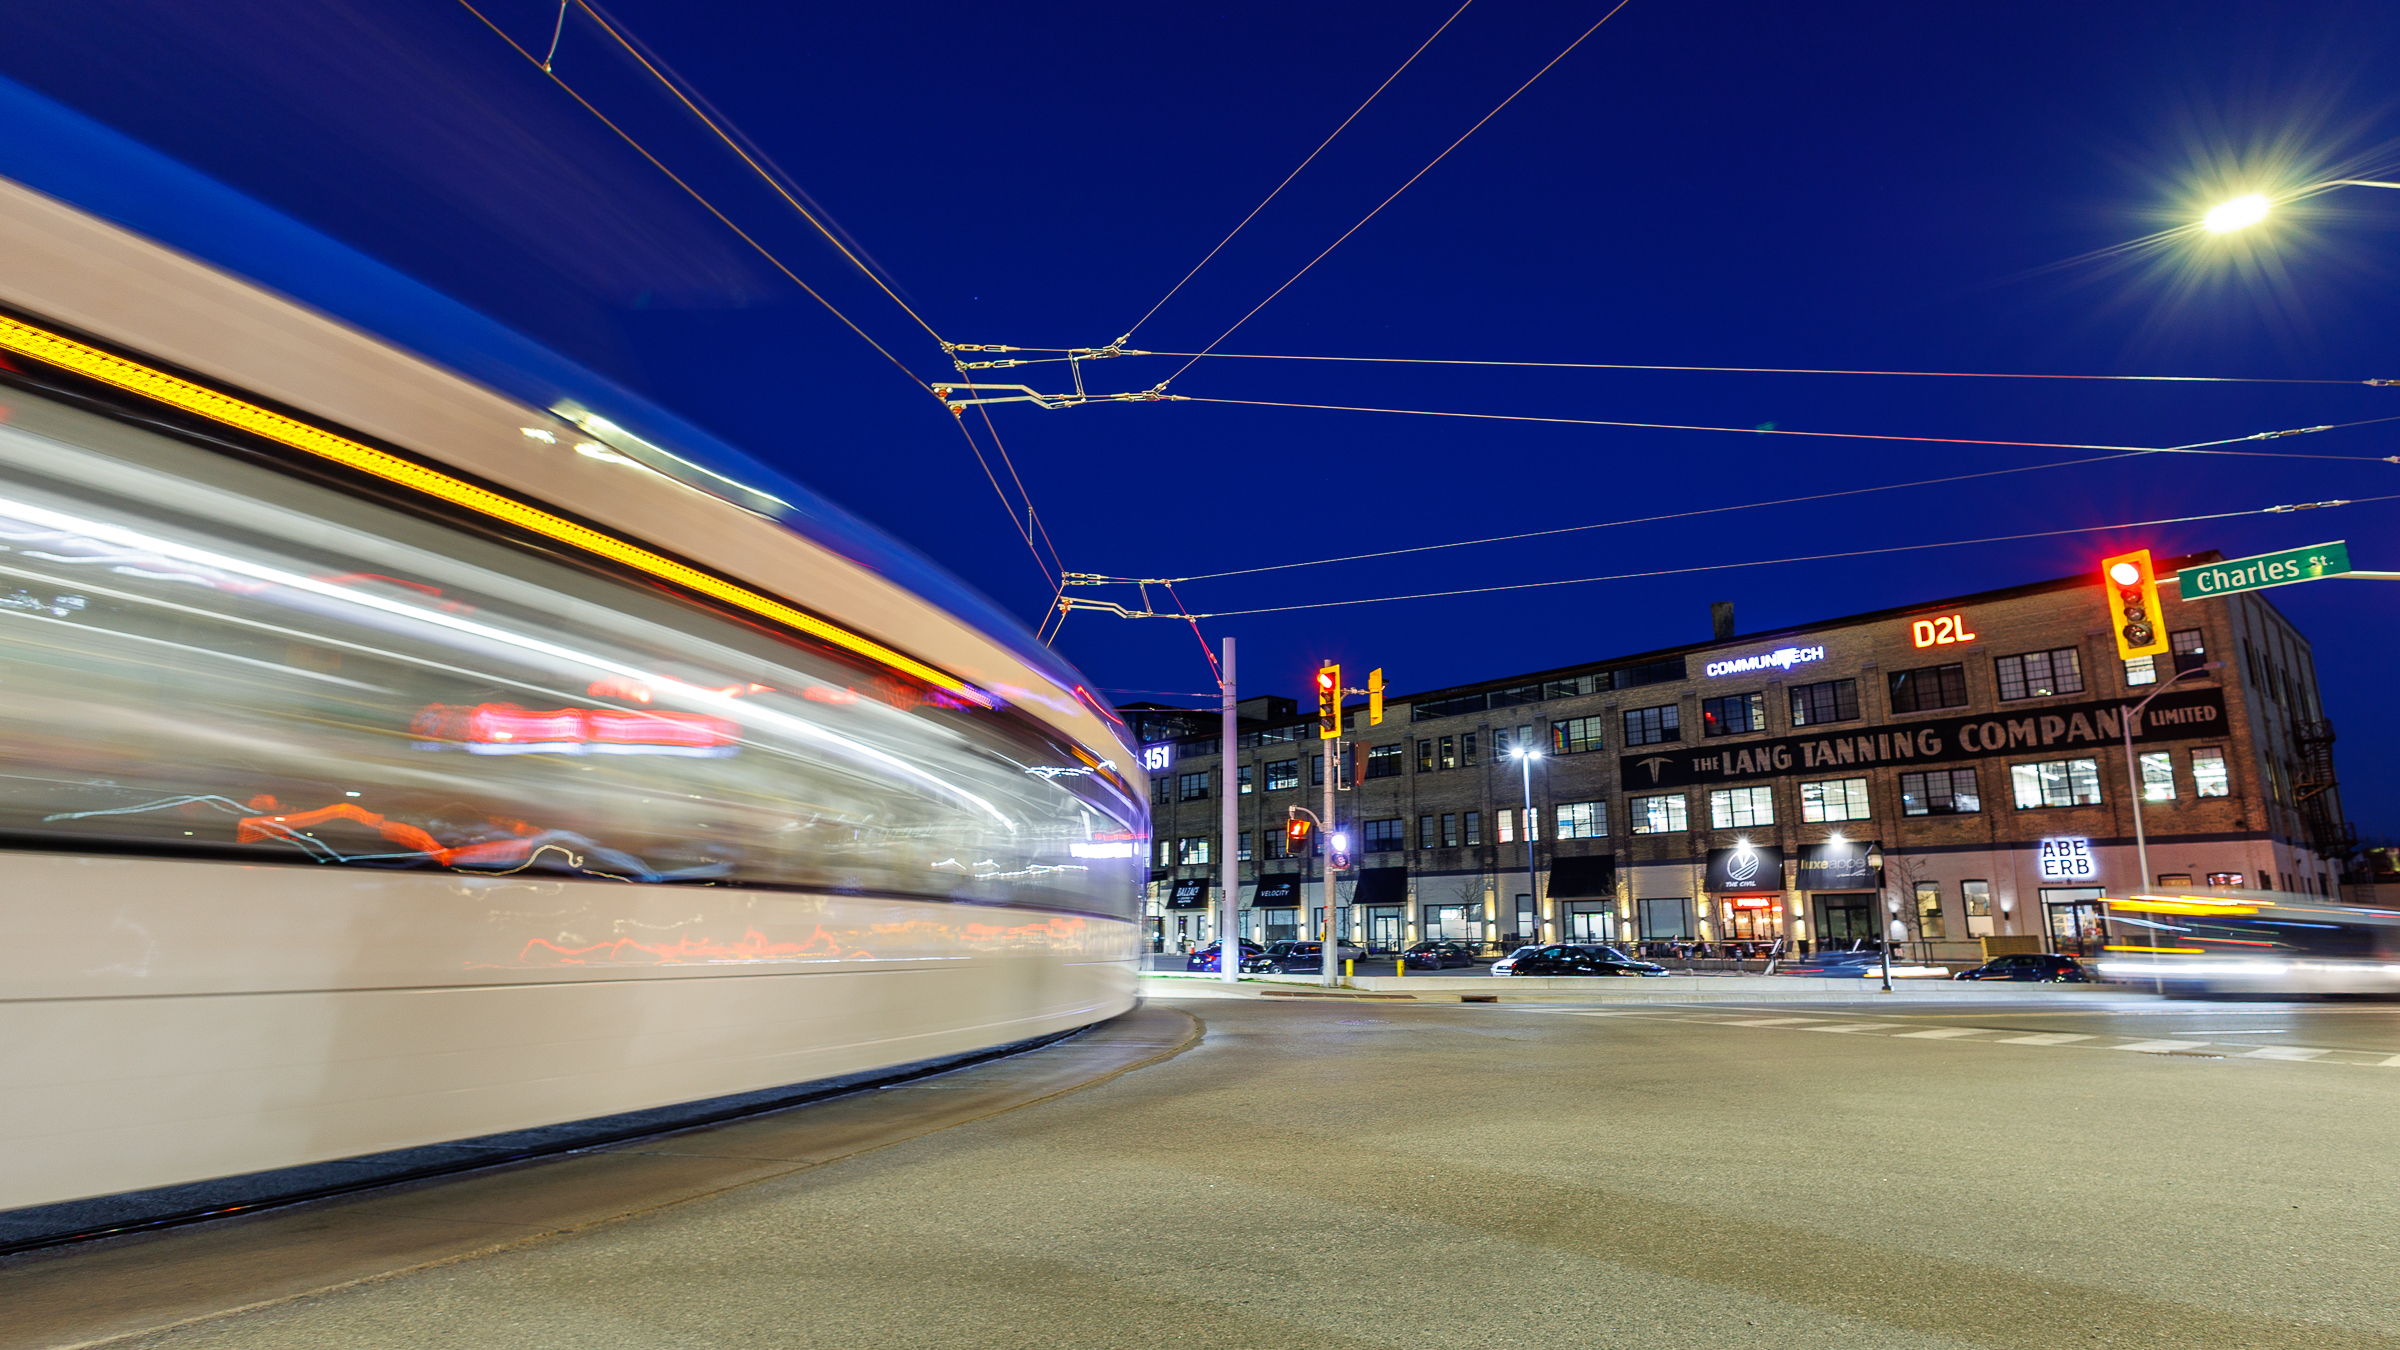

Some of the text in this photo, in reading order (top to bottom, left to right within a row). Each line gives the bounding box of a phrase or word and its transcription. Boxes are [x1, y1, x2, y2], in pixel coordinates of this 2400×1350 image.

[2196, 555, 2334, 592] Charles St.
[1912, 614, 1976, 648] D2L
[1692, 705, 2217, 776] THE LANG TANNING COMPANY LIMITED
[1144, 745, 1170, 770] 151
[2043, 840, 2087, 857] ABE
[1801, 858, 1867, 870] luxeappe
[2043, 858, 2090, 876] ERB
